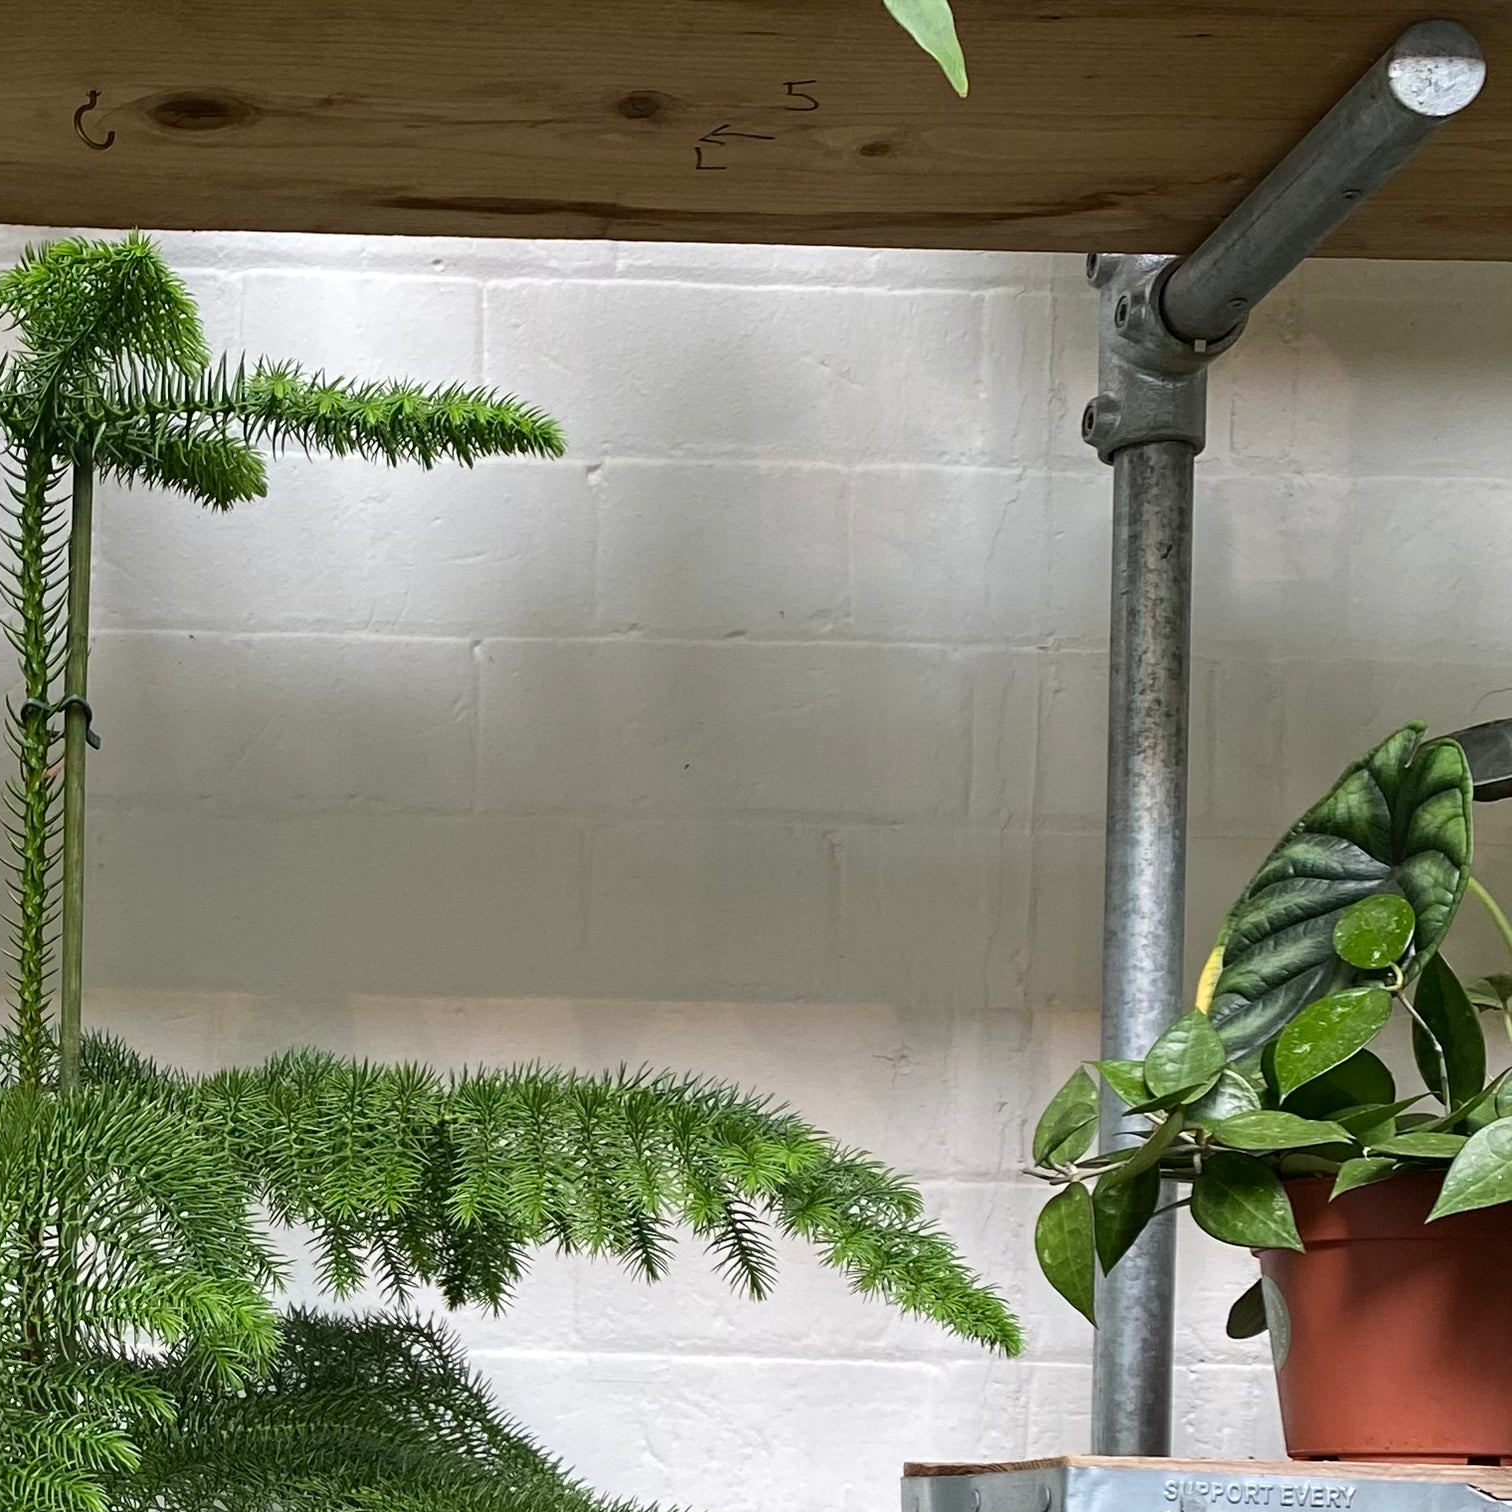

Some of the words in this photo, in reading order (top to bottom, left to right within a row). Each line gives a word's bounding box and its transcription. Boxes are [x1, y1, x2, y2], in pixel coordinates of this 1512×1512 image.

[782, 79, 819, 112] 5
[1163, 1479, 1274, 1505] SUPPORT
[1280, 1483, 1357, 1509] EVERY
